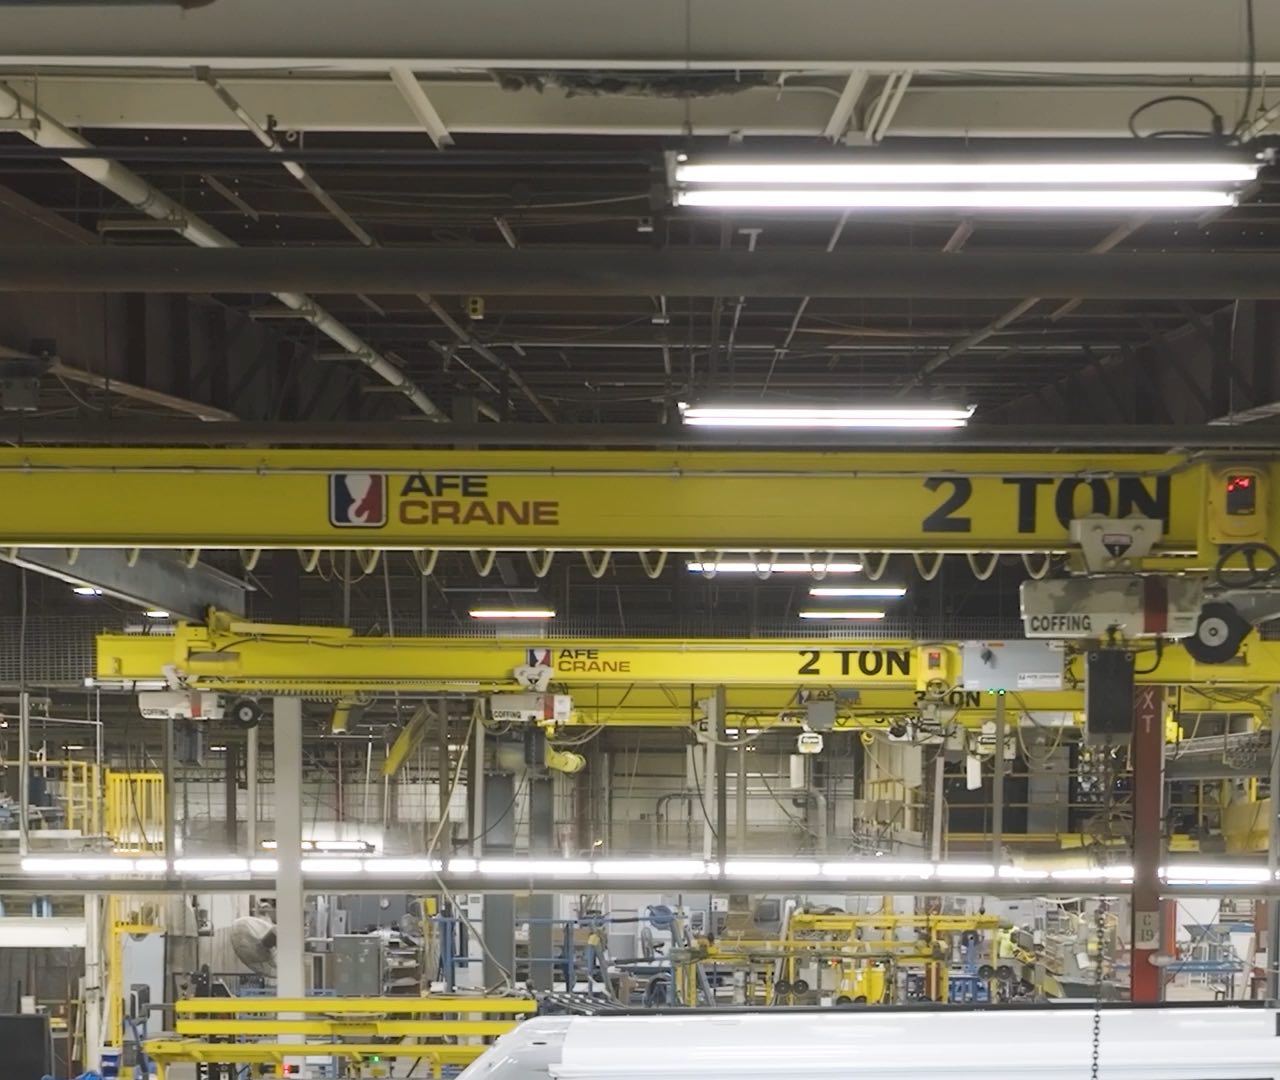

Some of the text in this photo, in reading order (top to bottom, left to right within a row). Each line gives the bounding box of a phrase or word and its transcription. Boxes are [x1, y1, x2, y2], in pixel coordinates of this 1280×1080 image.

[400, 474, 488, 497] AFE
[399, 500, 559, 526] CRANE
[922, 477, 1170, 535] 2 TON
[1030, 616, 1092, 632] COFFING
[559, 649, 599, 660] AFE
[558, 660, 631, 673] CRANE
[798, 650, 911, 676] 2 TON
[493, 711, 522, 719] COFFING
[1143, 914, 1152, 926] C
[1141, 929, 1154, 942] 19
